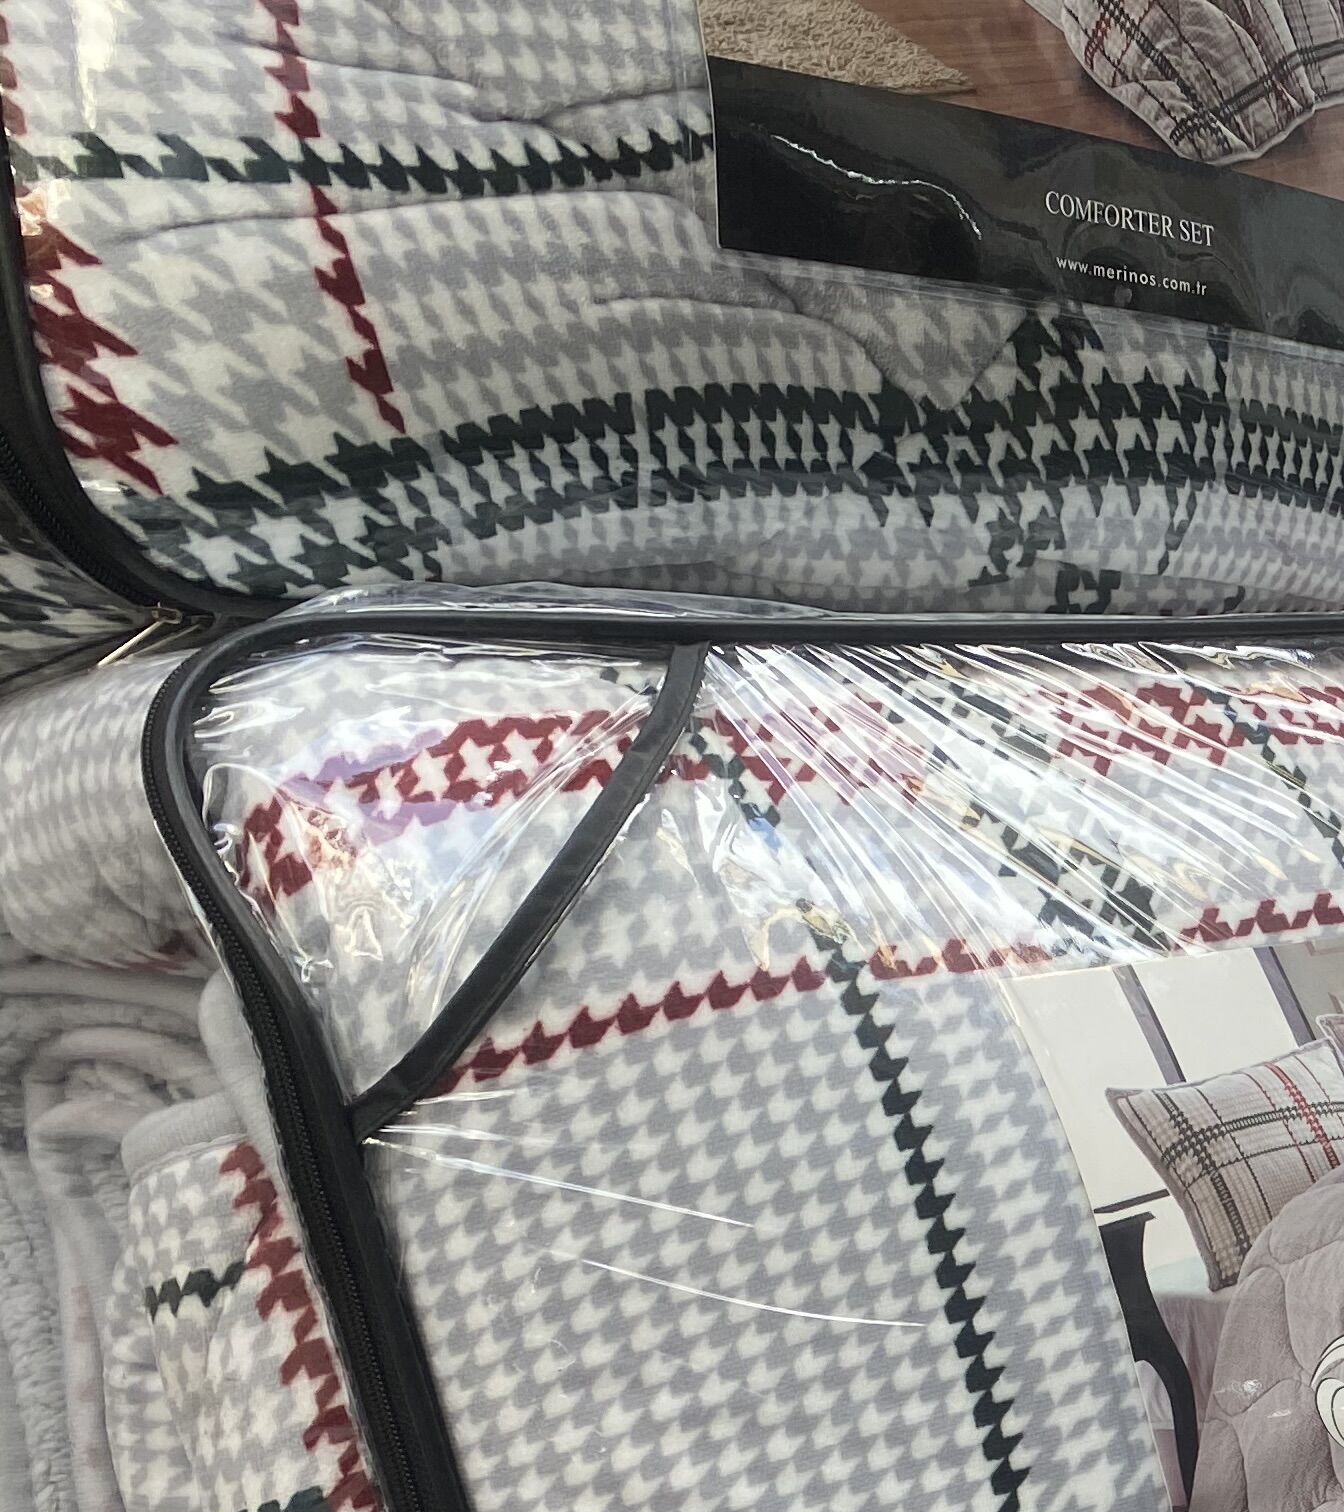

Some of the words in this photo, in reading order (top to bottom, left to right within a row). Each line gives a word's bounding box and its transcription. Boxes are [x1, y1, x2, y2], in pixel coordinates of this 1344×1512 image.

[1045, 190, 1175, 239] COMFORTER
[1179, 219, 1214, 247] SET
[1056, 256, 1208, 296] www.merinos.com.tr
